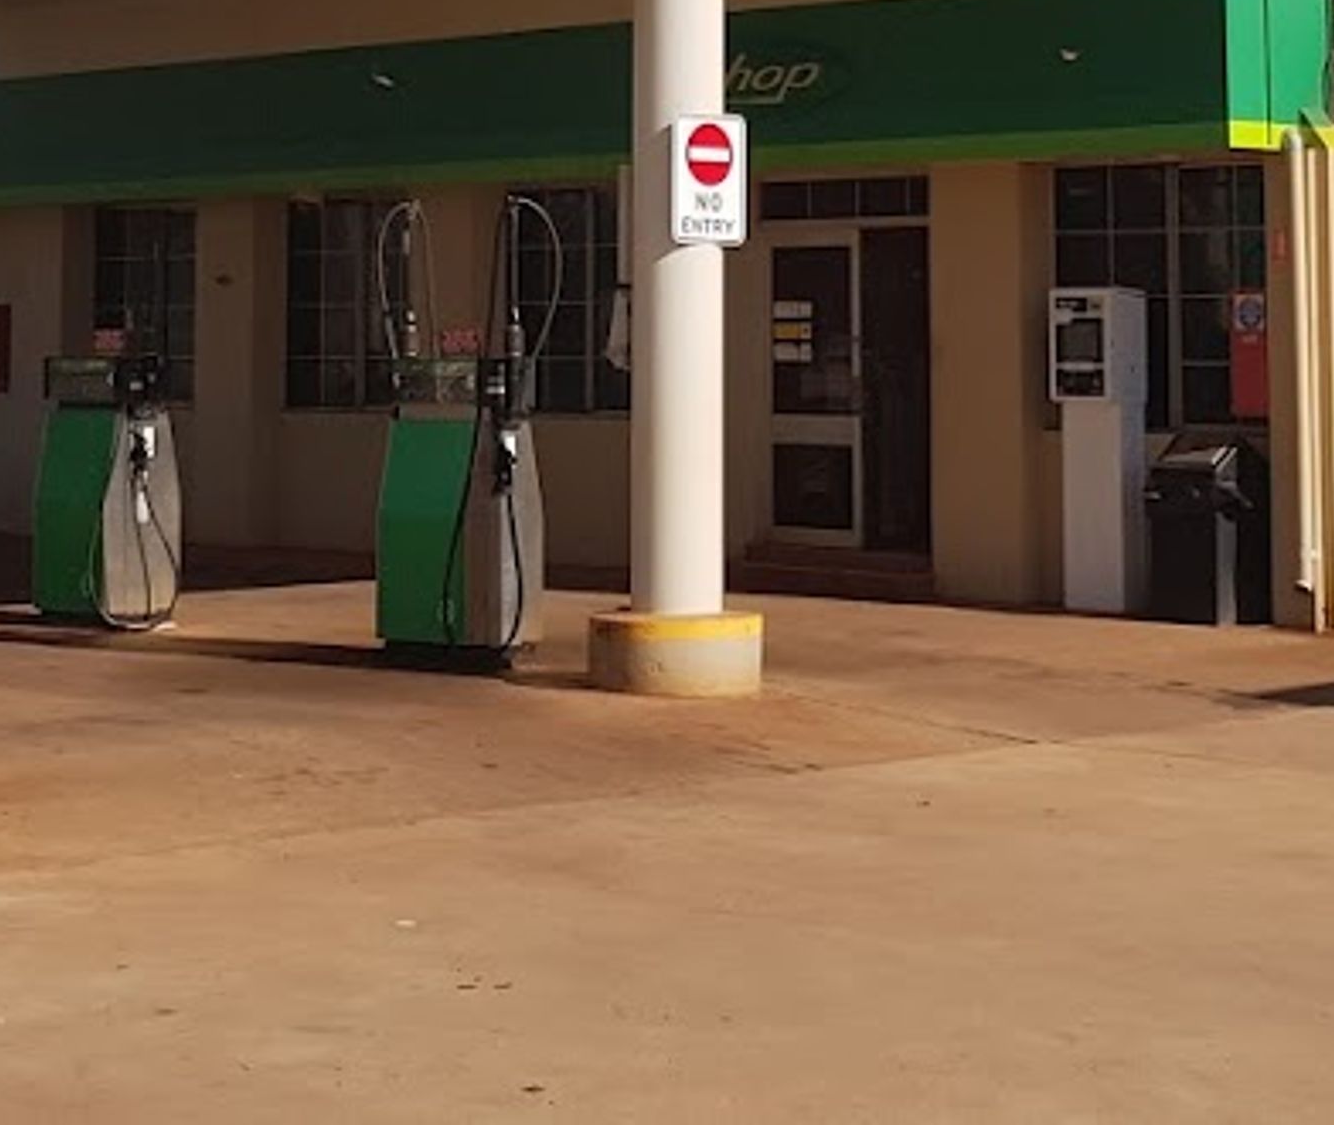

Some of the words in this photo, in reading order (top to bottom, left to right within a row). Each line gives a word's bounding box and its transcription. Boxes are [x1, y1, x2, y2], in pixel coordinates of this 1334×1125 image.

[725, 53, 820, 105] hop
[694, 192, 723, 213] NO
[680, 216, 736, 235] ENTRY
